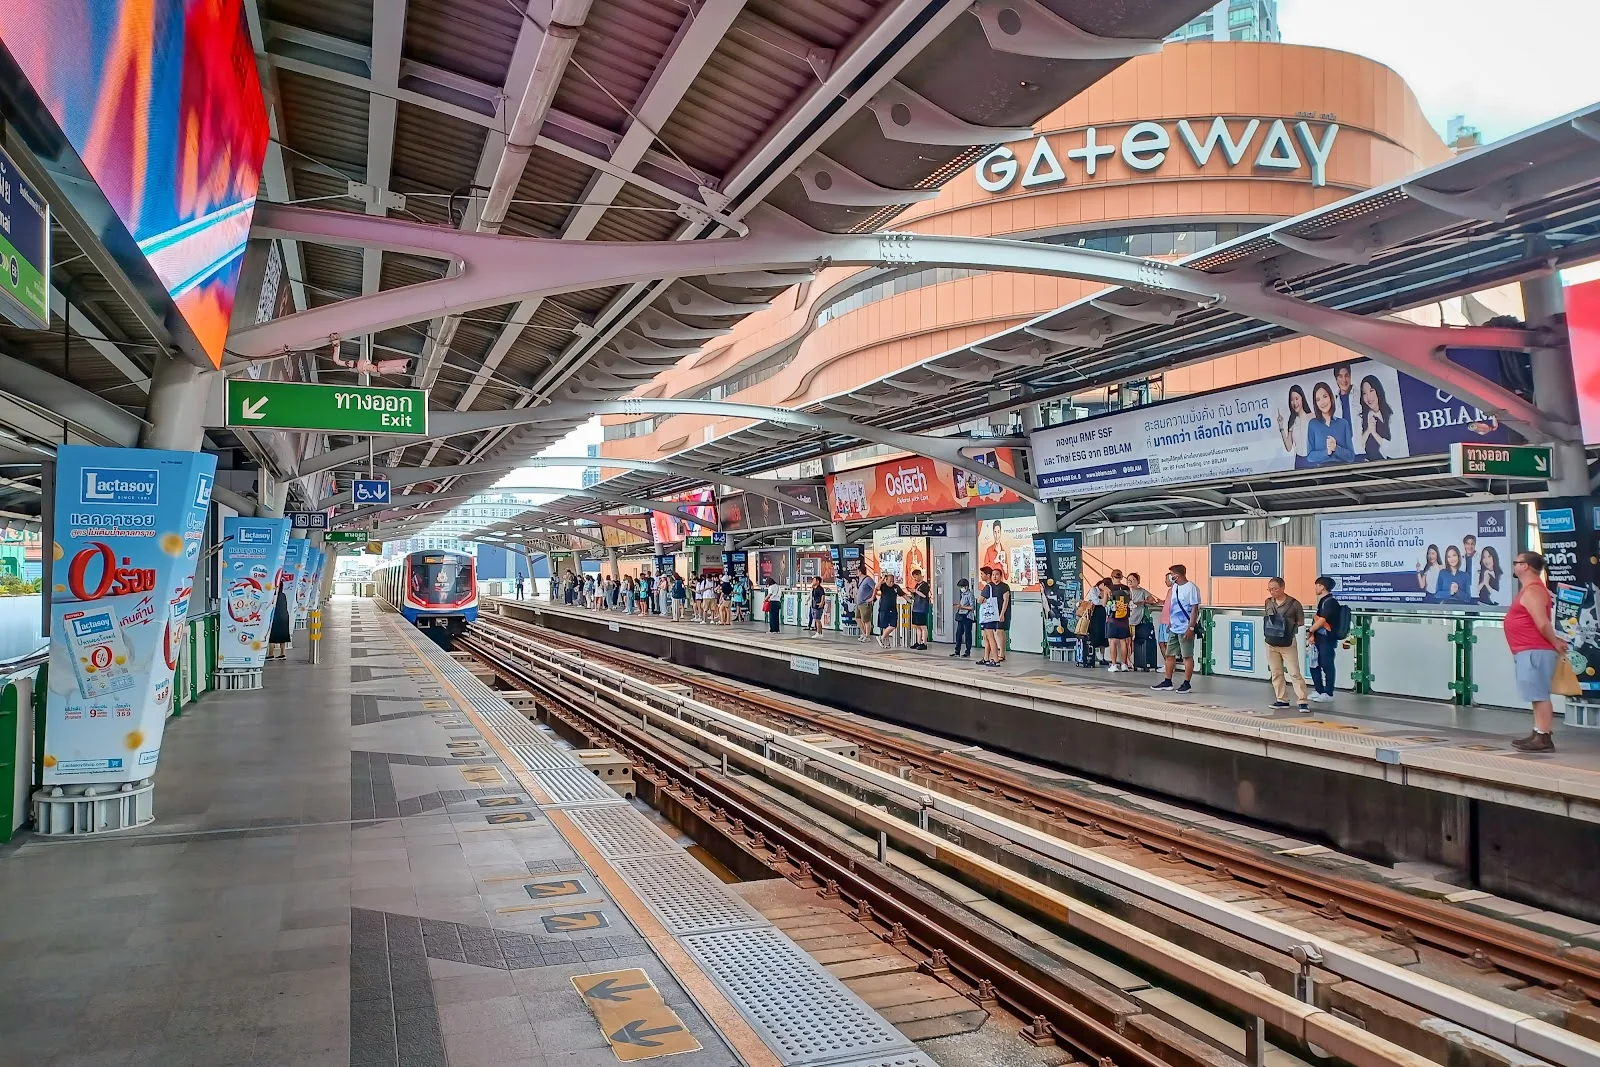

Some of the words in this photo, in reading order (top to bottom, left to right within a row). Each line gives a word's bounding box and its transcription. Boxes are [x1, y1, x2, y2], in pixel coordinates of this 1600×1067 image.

[334, 392, 412, 413] ทางออก
[1218, 404, 1233, 418] กับ
[1234, 398, 1269, 414] โอกาส
[381, 413, 412, 427] Exit
[1055, 437, 1078, 447] กองทุน
[1079, 430, 1096, 443] RMF
[1098, 427, 1113, 439] SSF
[1153, 428, 1191, 448] มากกว่า
[1194, 420, 1233, 441] เลือกได้
[1236, 413, 1272, 433] ตามใจ
[1056, 453, 1071, 464] Thai
[1071, 450, 1087, 462] ESG
[1103, 442, 1132, 456] BBLAM
[1467, 449, 1510, 462] ทางออก
[1186, 461, 1202, 469] Trading
[1468, 461, 1486, 472] Exit
[86, 473, 154, 499] Lactasoy
[70, 513, 156, 527] แลคตาซอย
[1537, 513, 1571, 530] Lactasoy
[240, 529, 271, 542] Lactasoy
[1365, 537, 1395, 548] เลือกได้
[1397, 536, 1424, 547] ตามใจ
[1228, 545, 1258, 561] เอกมัย
[1224, 563, 1251, 571] Ekkamai
[1380, 560, 1404, 568] BBLAM
[119, 604, 155, 627] เกินต้าน
[74, 617, 111, 636] Lactasoy
[90, 709, 97, 718] 9
